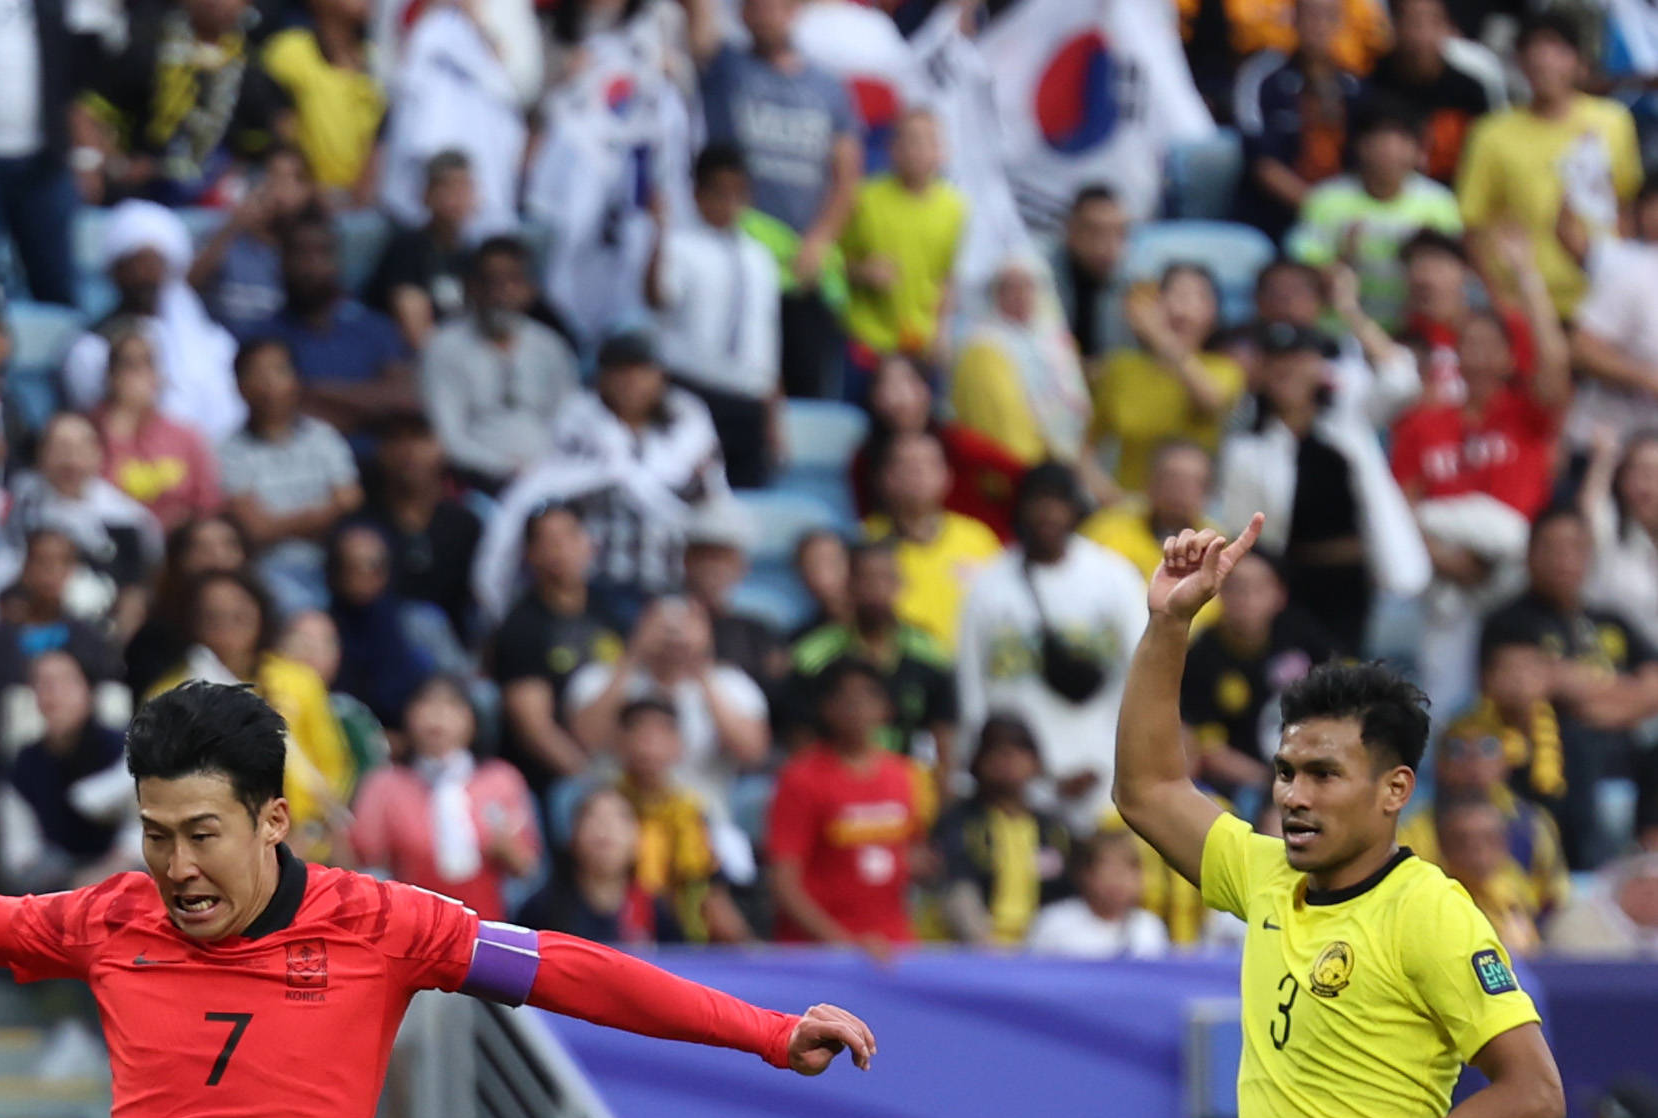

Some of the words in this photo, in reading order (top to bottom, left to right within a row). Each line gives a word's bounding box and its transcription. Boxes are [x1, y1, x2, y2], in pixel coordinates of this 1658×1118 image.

[285, 990, 326, 1003] KOREA
[1270, 971, 1299, 1051] 3
[204, 1011, 254, 1087] 7
